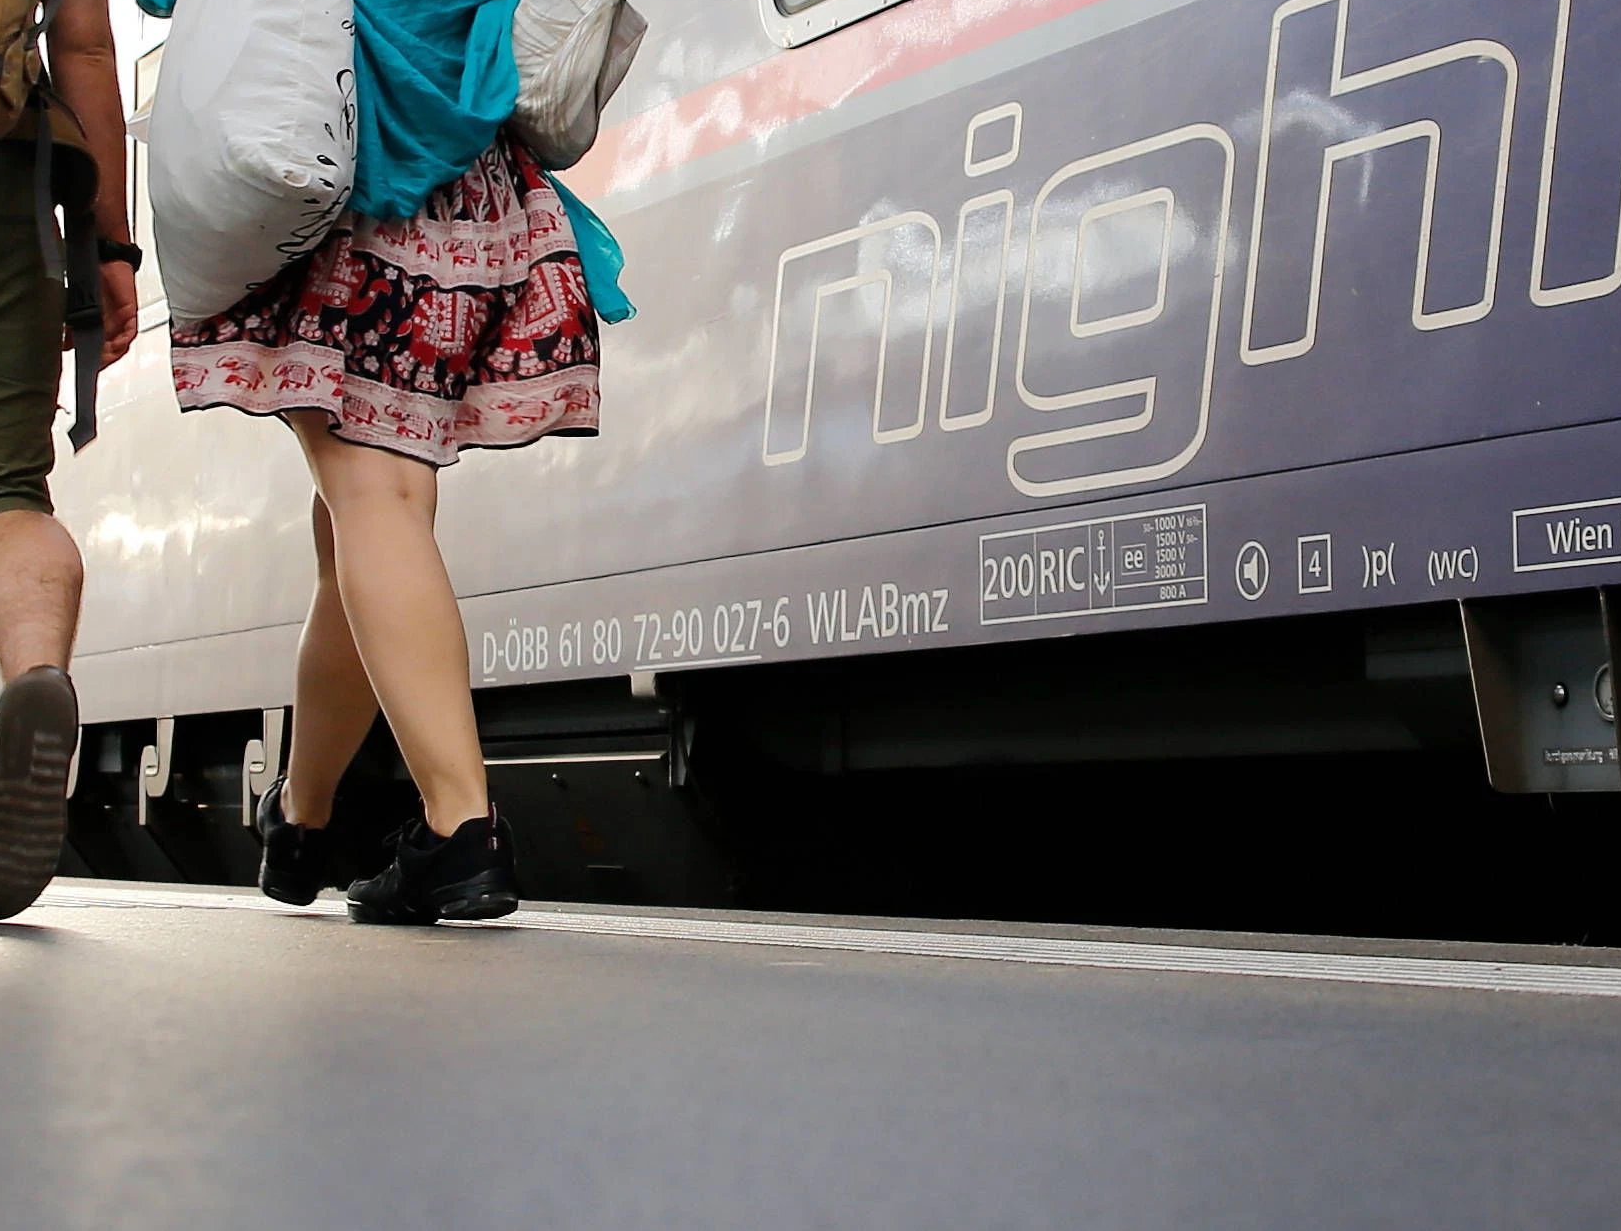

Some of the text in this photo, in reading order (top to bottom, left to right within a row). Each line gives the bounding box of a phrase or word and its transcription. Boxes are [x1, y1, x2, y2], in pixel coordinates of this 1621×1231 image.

[1177, 514, 1185, 529] V
[1156, 532, 1177, 547] 1500
[1178, 530, 1186, 545] V
[1546, 517, 1613, 555] Wien
[1124, 549, 1144, 569] ee
[1156, 546, 1186, 563] 1500 V
[1308, 550, 1322, 578] 4
[1428, 545, 1479, 586] (WC)
[983, 553, 1035, 602] 200
[1040, 546, 1086, 595] RIC
[1178, 562, 1186, 576] V
[1179, 584, 1186, 598] A
[483, 582, 949, 674] D-ÖBB 61 80 72-90 027-6 WLABmz
